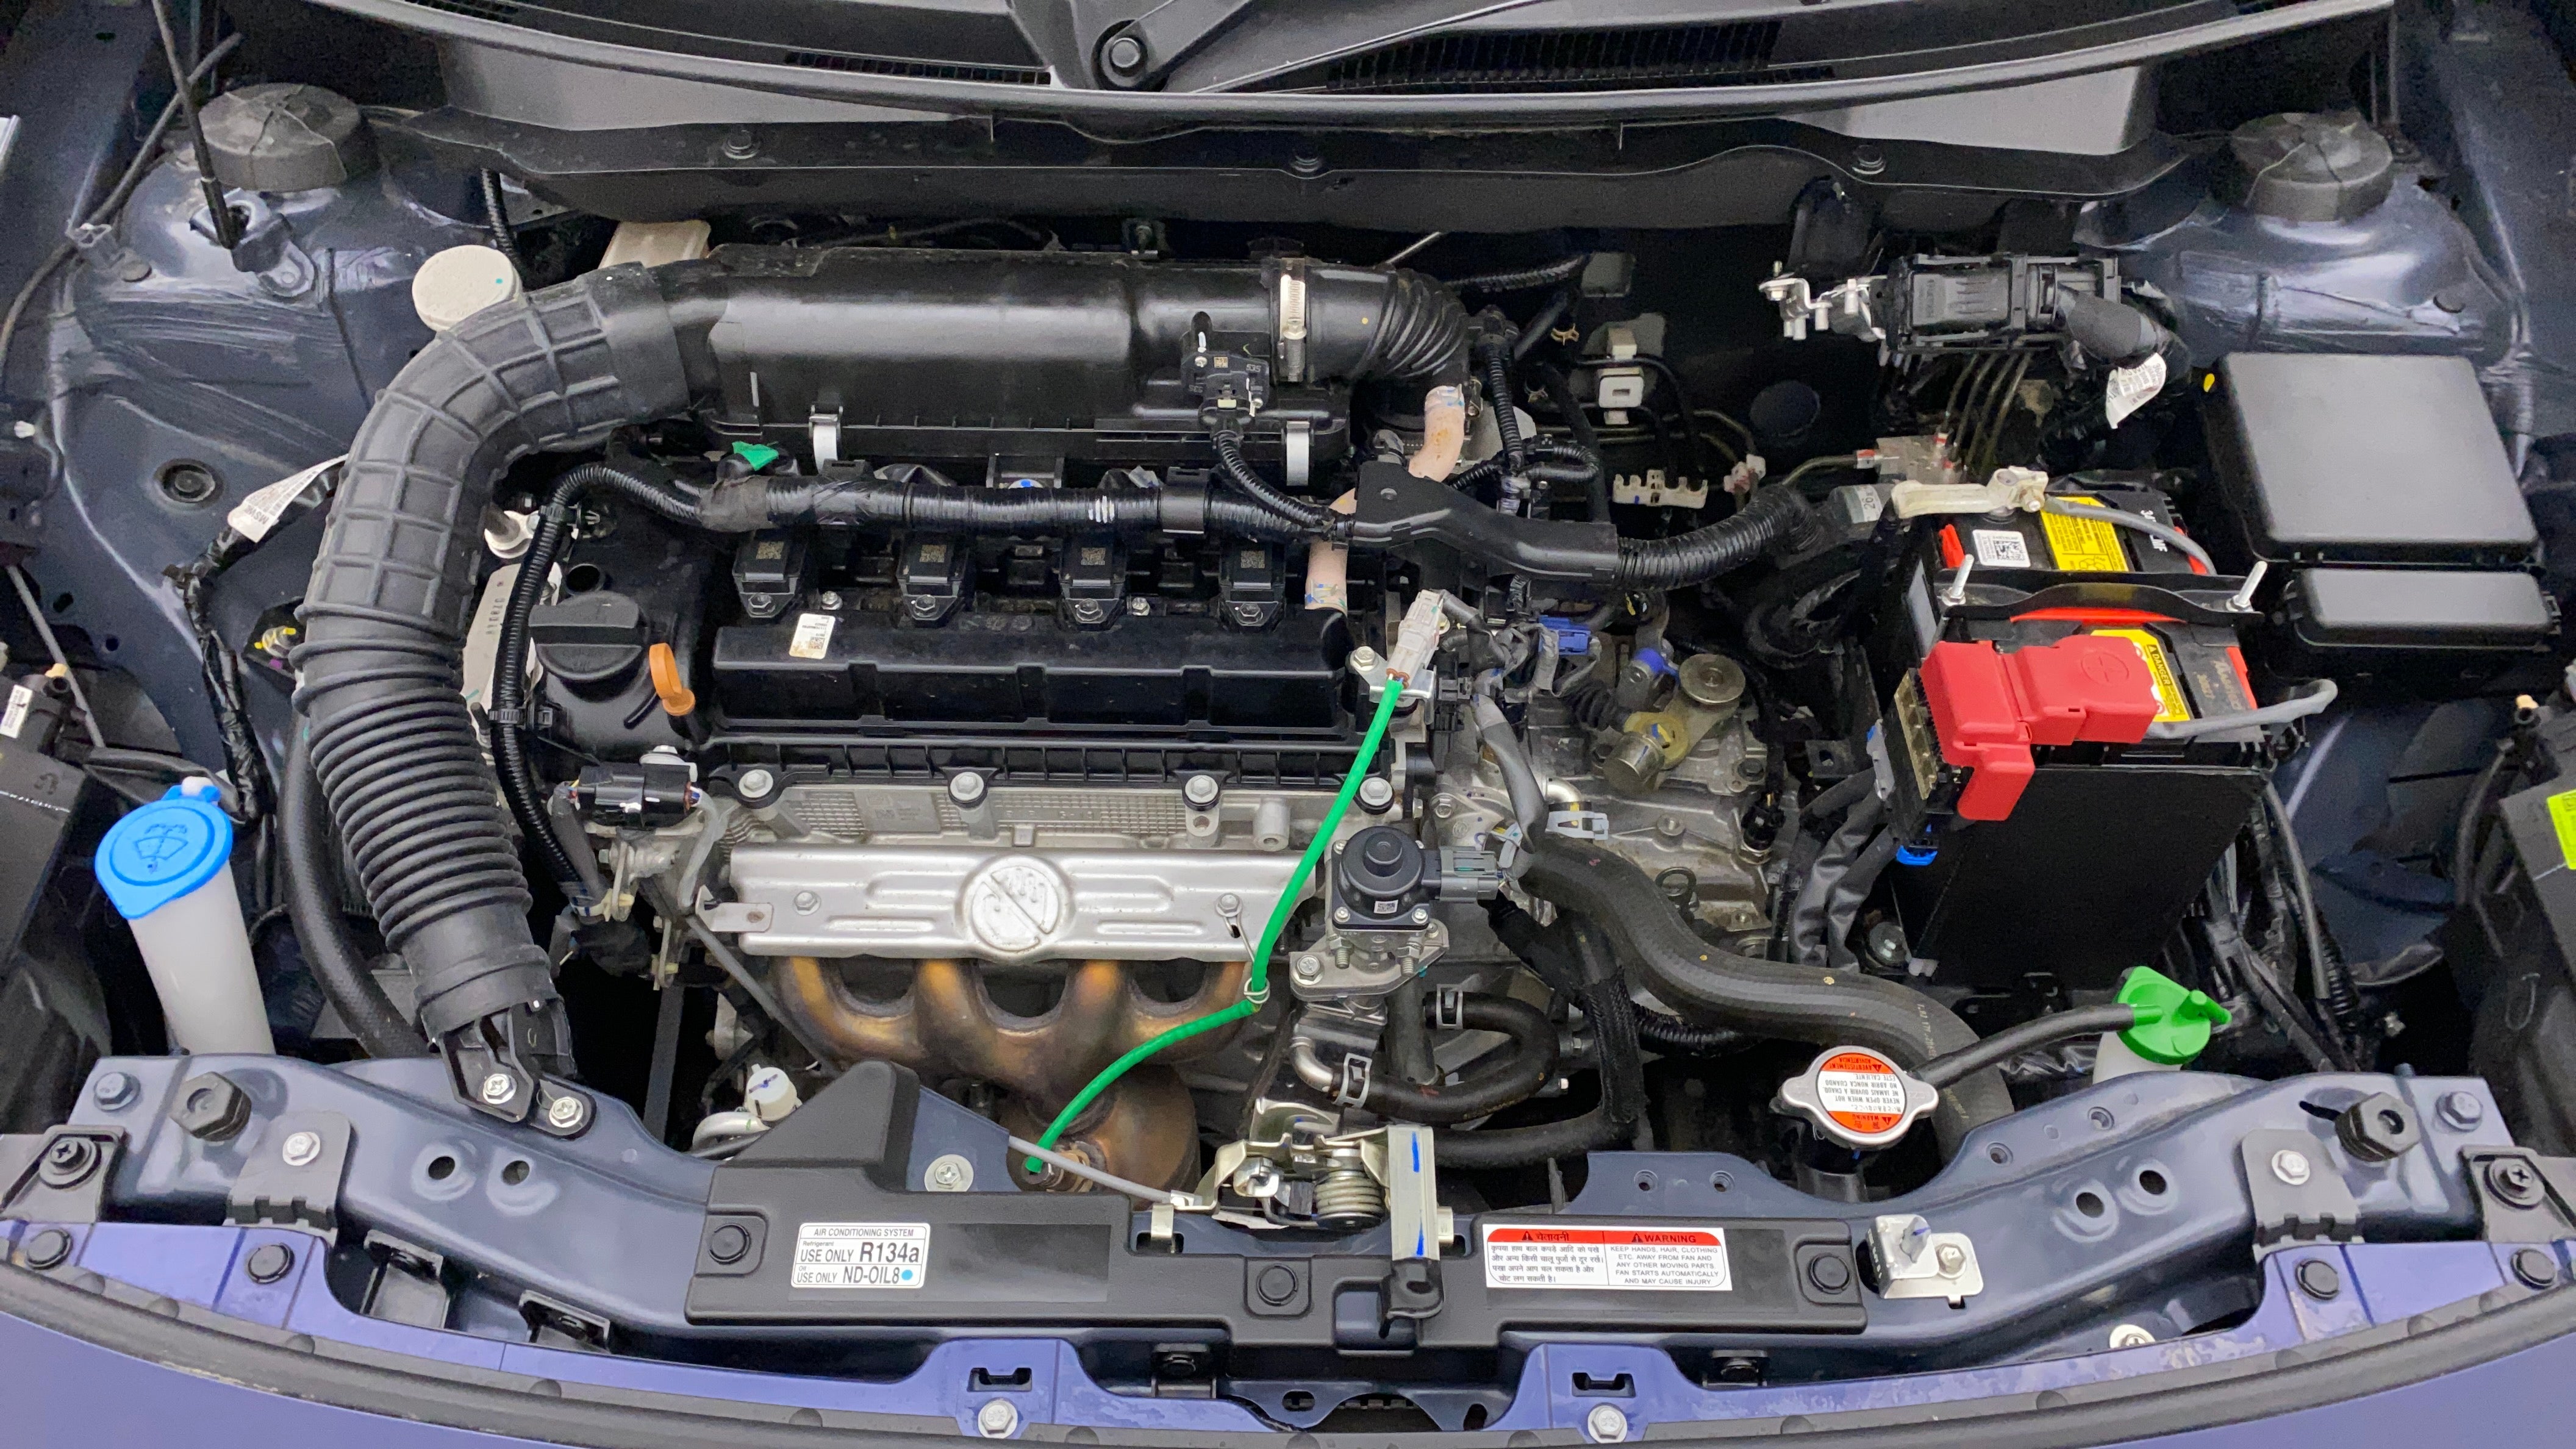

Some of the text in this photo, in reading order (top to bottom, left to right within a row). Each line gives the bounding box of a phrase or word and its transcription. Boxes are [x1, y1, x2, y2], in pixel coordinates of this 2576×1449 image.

[2152, 653, 2172, 685] DANGER
[1645, 1234, 1697, 1243] WARNING
[801, 1242, 920, 1263] USE ONLY R134a
[797, 1266, 900, 1284] USE ONLY ND-OIL8
